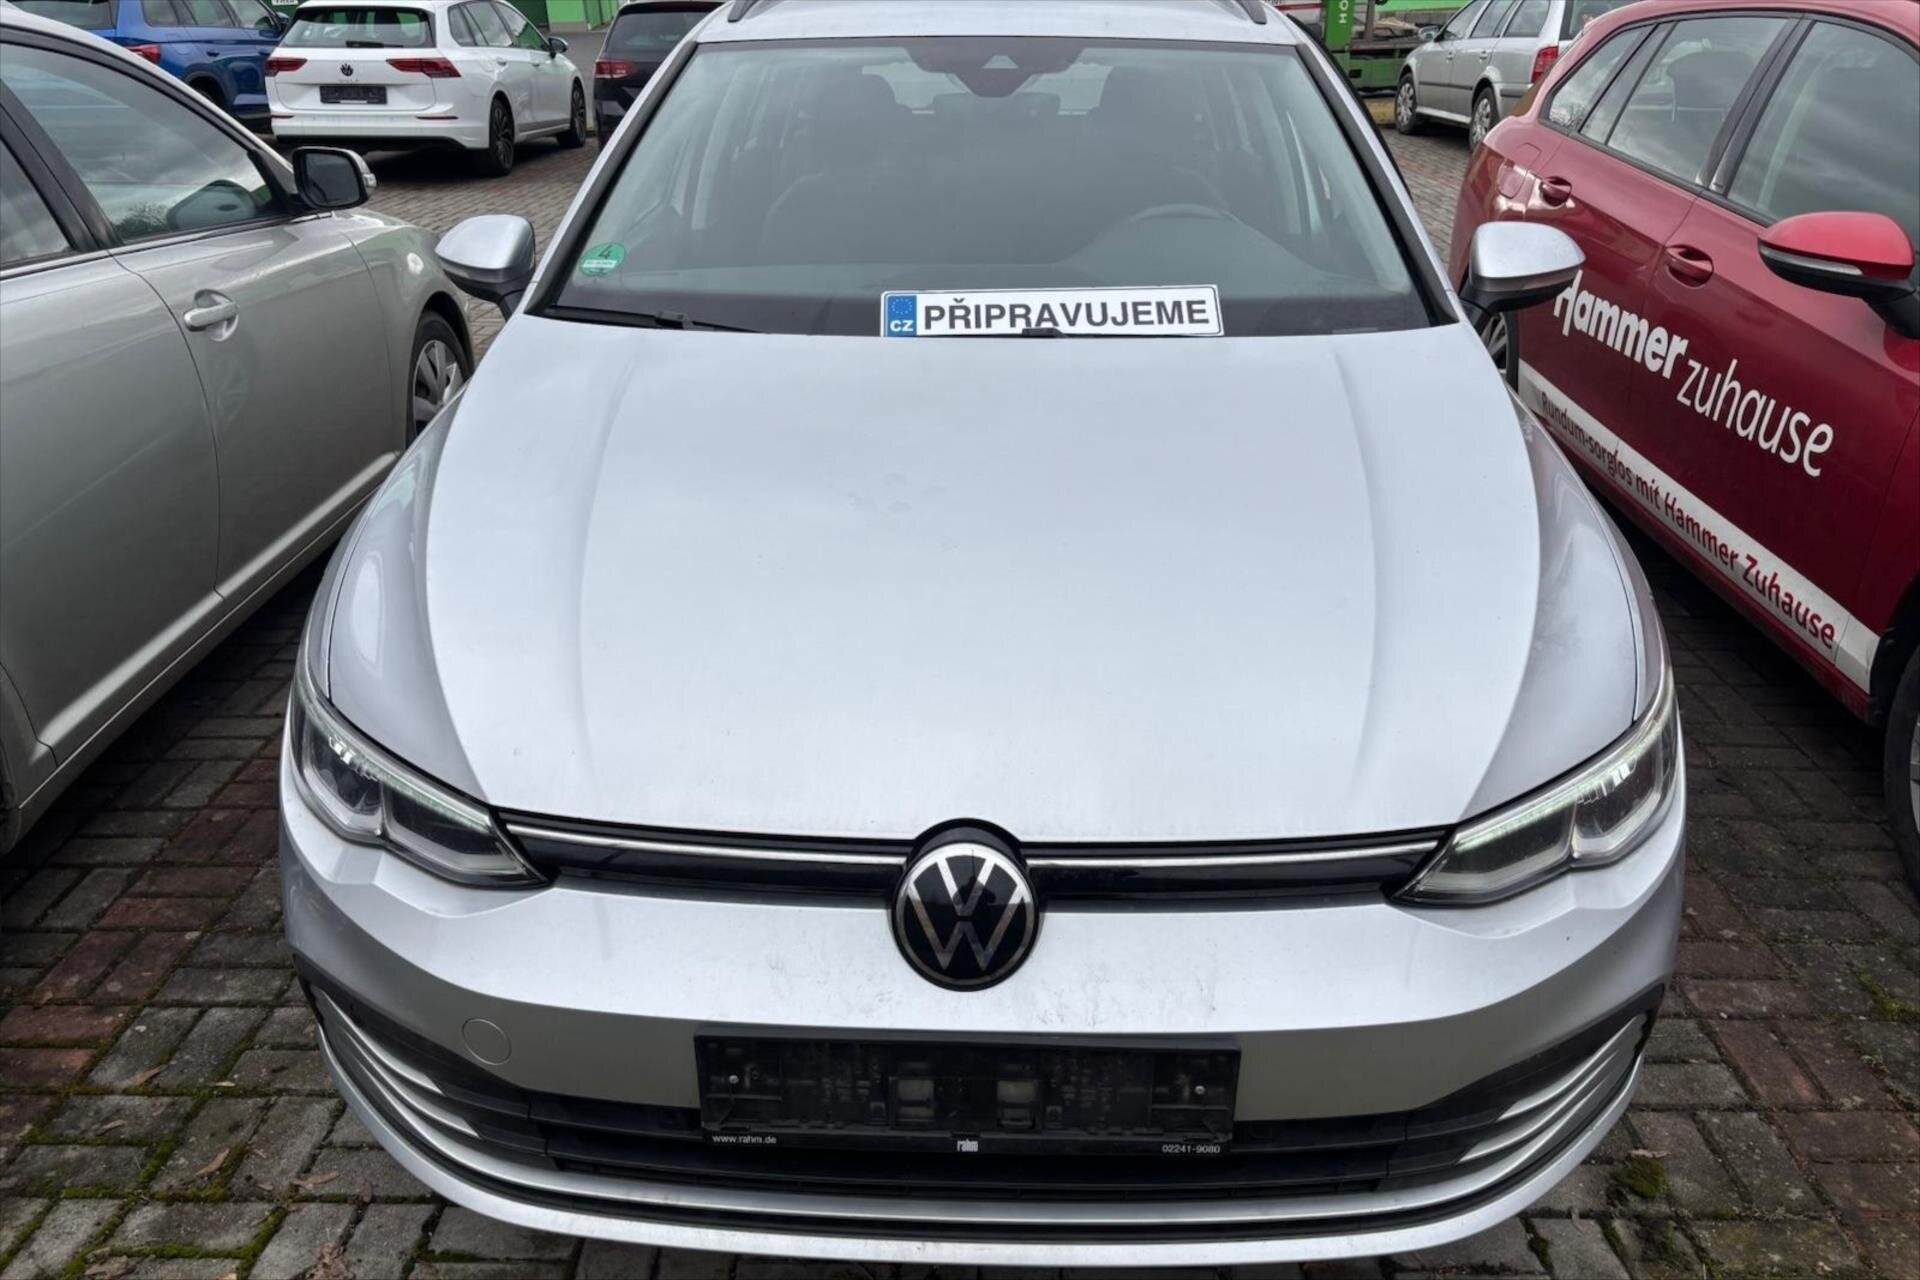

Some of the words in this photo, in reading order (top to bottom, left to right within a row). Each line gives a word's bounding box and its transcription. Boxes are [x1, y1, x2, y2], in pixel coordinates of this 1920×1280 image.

[598, 243, 613, 259] 4
[890, 319, 914, 332] CZ
[924, 297, 1210, 330] PŘIPRAVUJEME
[1553, 269, 1689, 379] Hammer
[1677, 358, 1834, 478] zuhause
[1541, 391, 1633, 486] Rundum-sorglos
[1636, 474, 1660, 510] mit
[1664, 492, 1739, 570] Hammer
[1742, 553, 1836, 649] Zuhause
[904, 852, 1027, 972] VW
